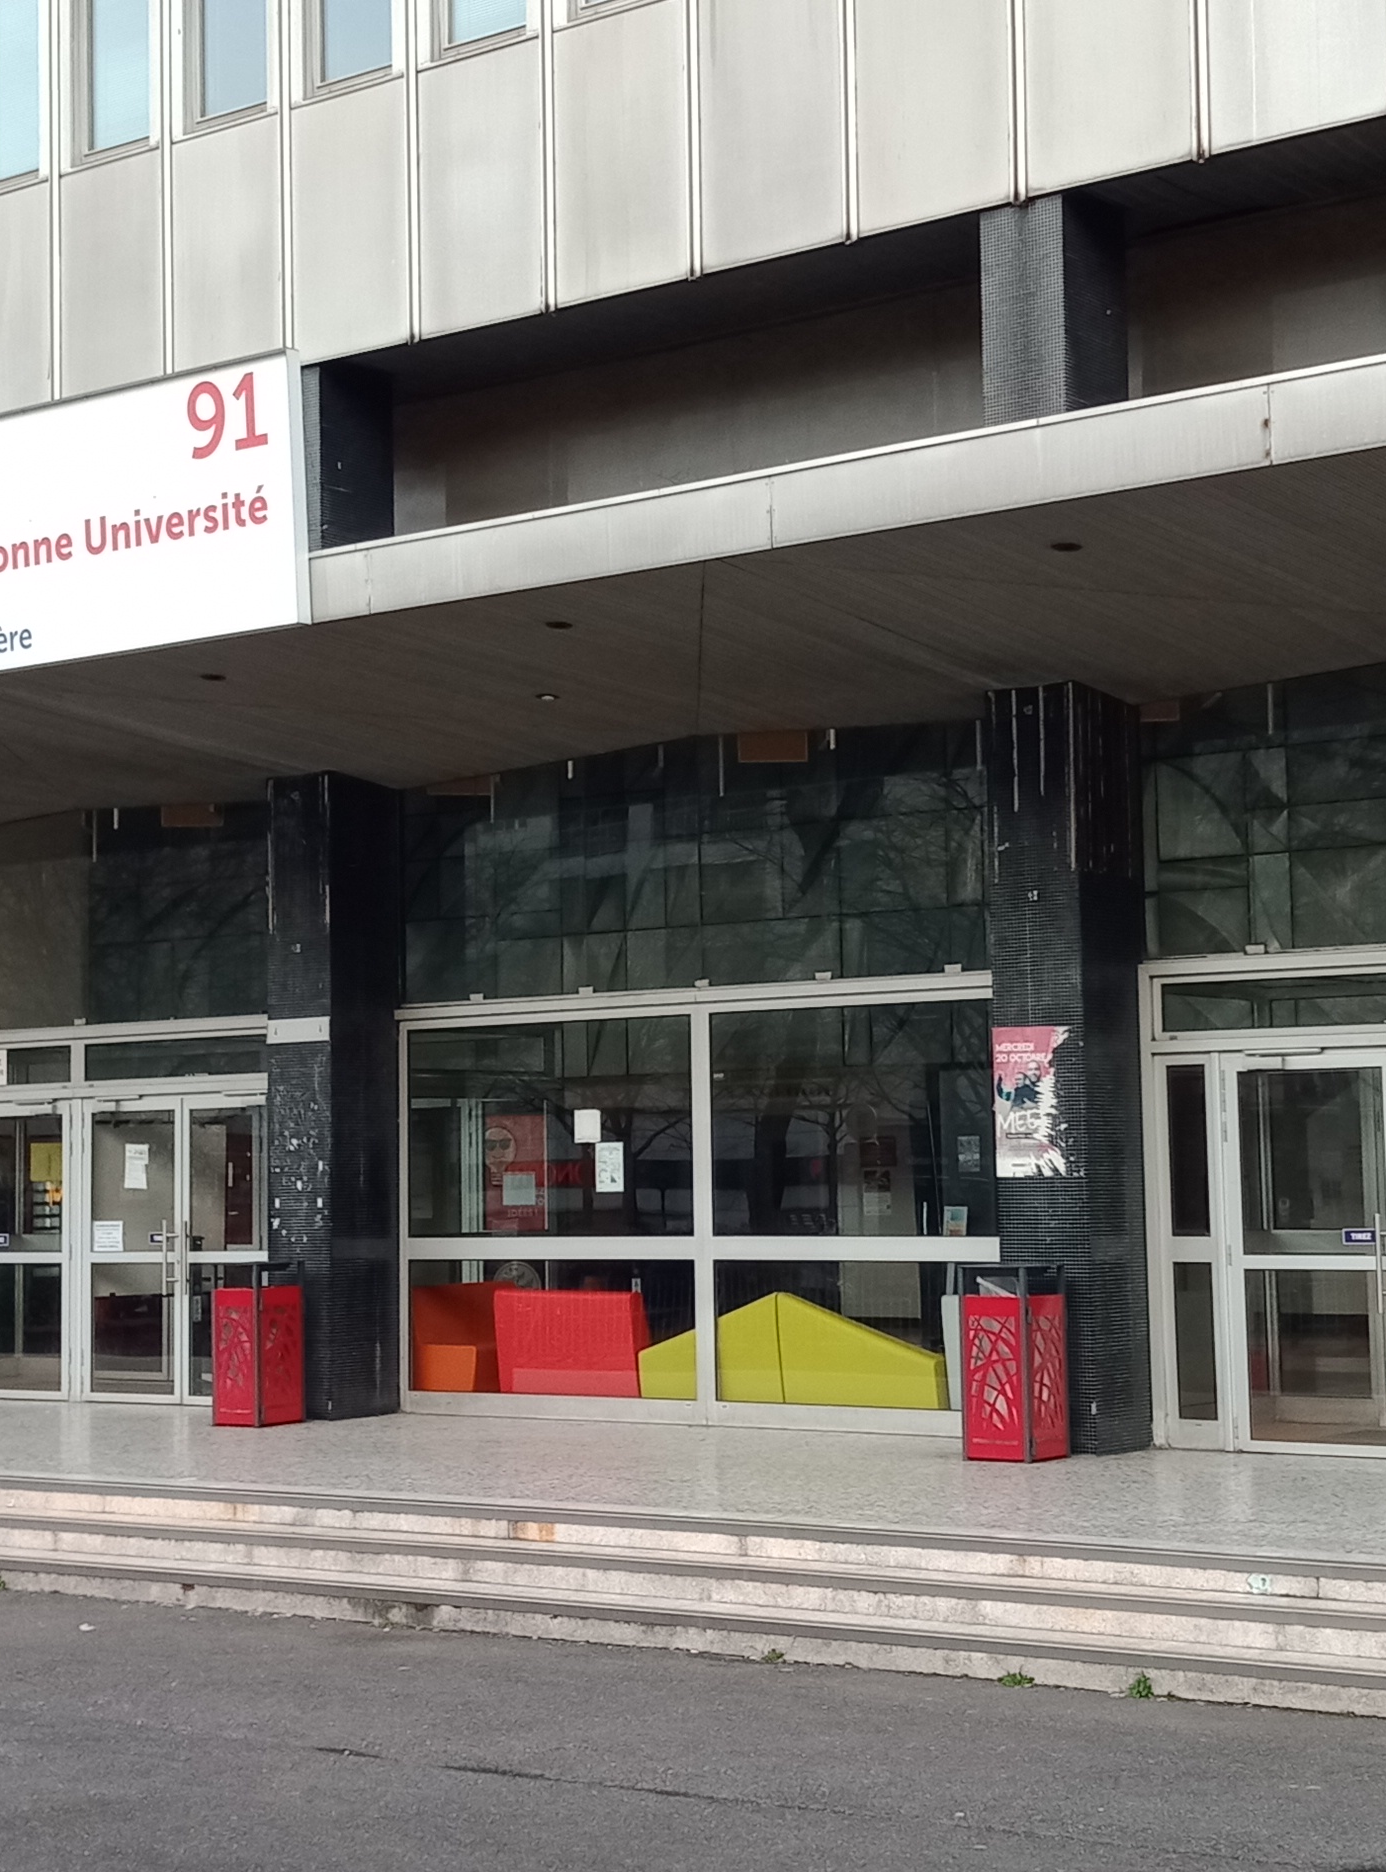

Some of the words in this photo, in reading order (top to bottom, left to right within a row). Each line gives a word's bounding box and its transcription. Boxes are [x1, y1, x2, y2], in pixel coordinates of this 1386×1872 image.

[186, 371, 269, 460] 91
[84, 484, 268, 556] Université
[995, 1053, 1009, 1063] 20
[1350, 1232, 1372, 1241] TIREZ
